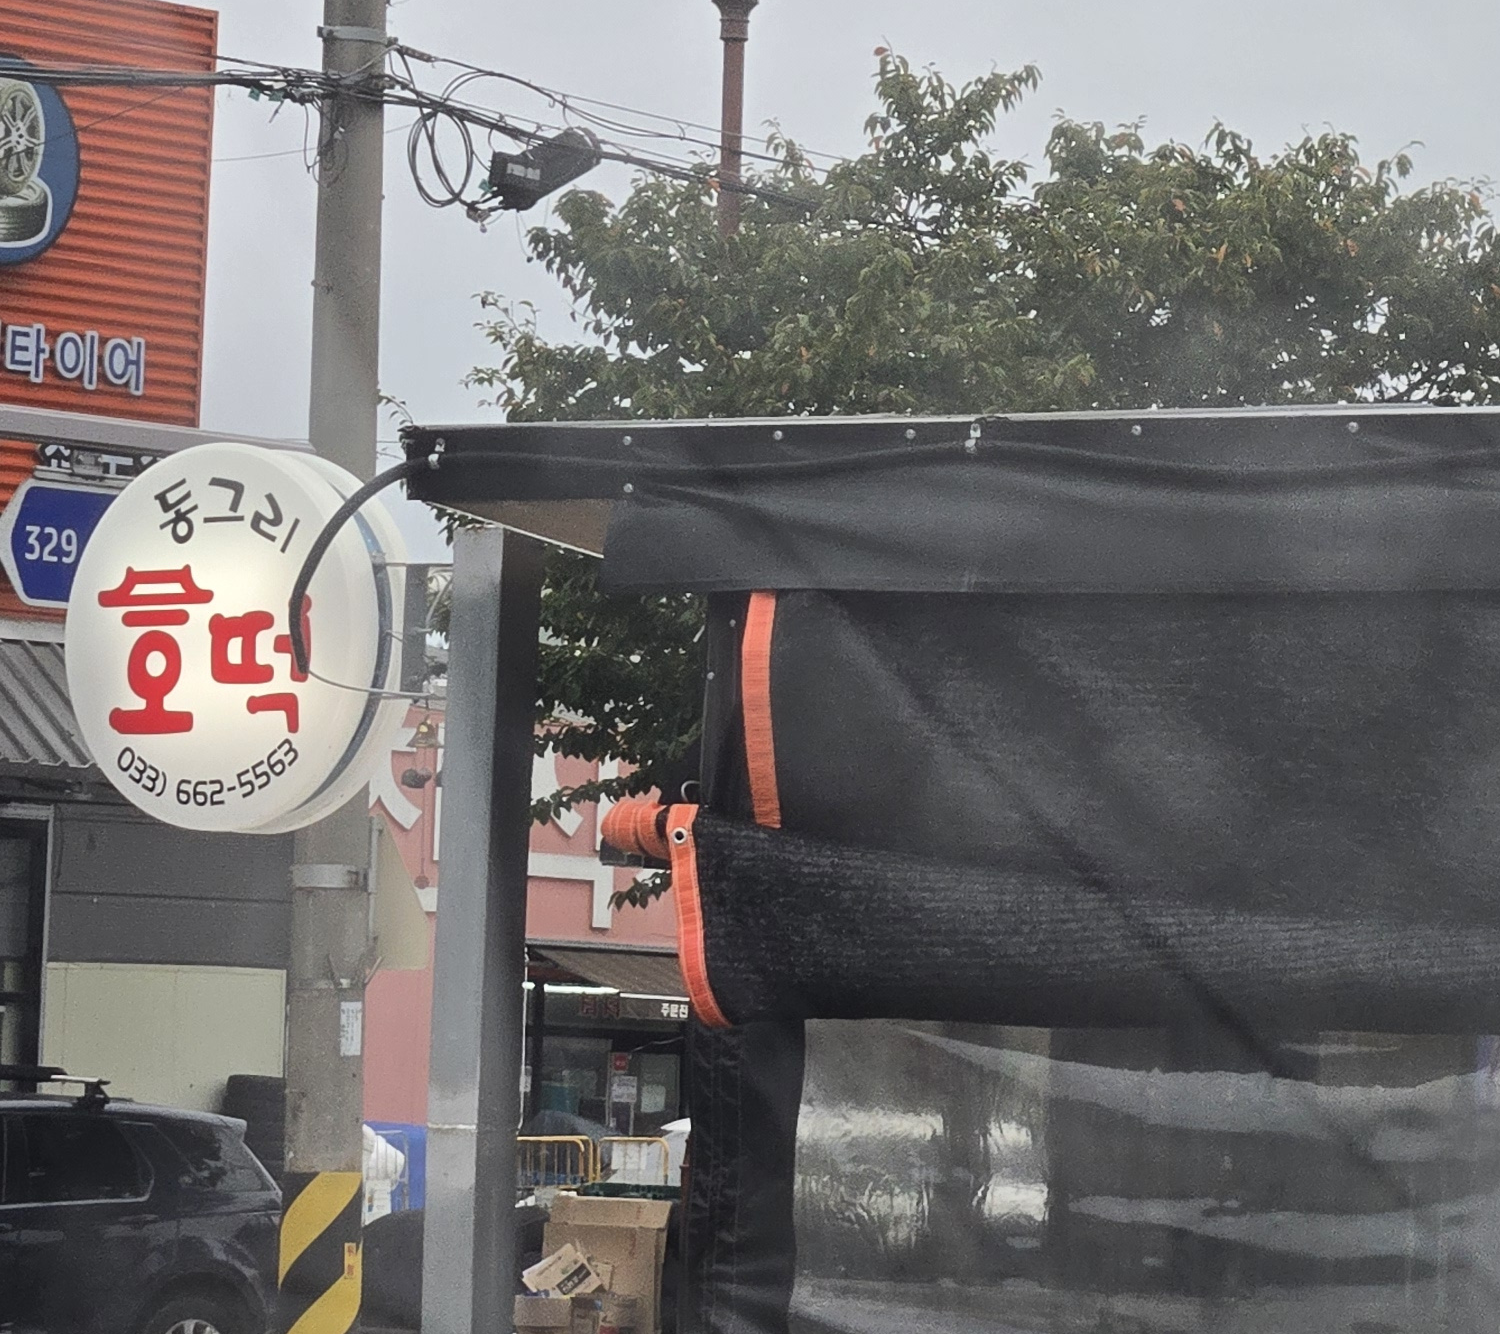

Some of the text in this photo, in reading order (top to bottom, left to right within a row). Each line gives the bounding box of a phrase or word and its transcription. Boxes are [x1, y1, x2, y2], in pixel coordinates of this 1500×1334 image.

[24, 525, 78, 564] 329
[154, 477, 300, 553] 동그리
[98, 564, 312, 735] 호떡
[116, 738, 300, 807] 033) 662-5563
